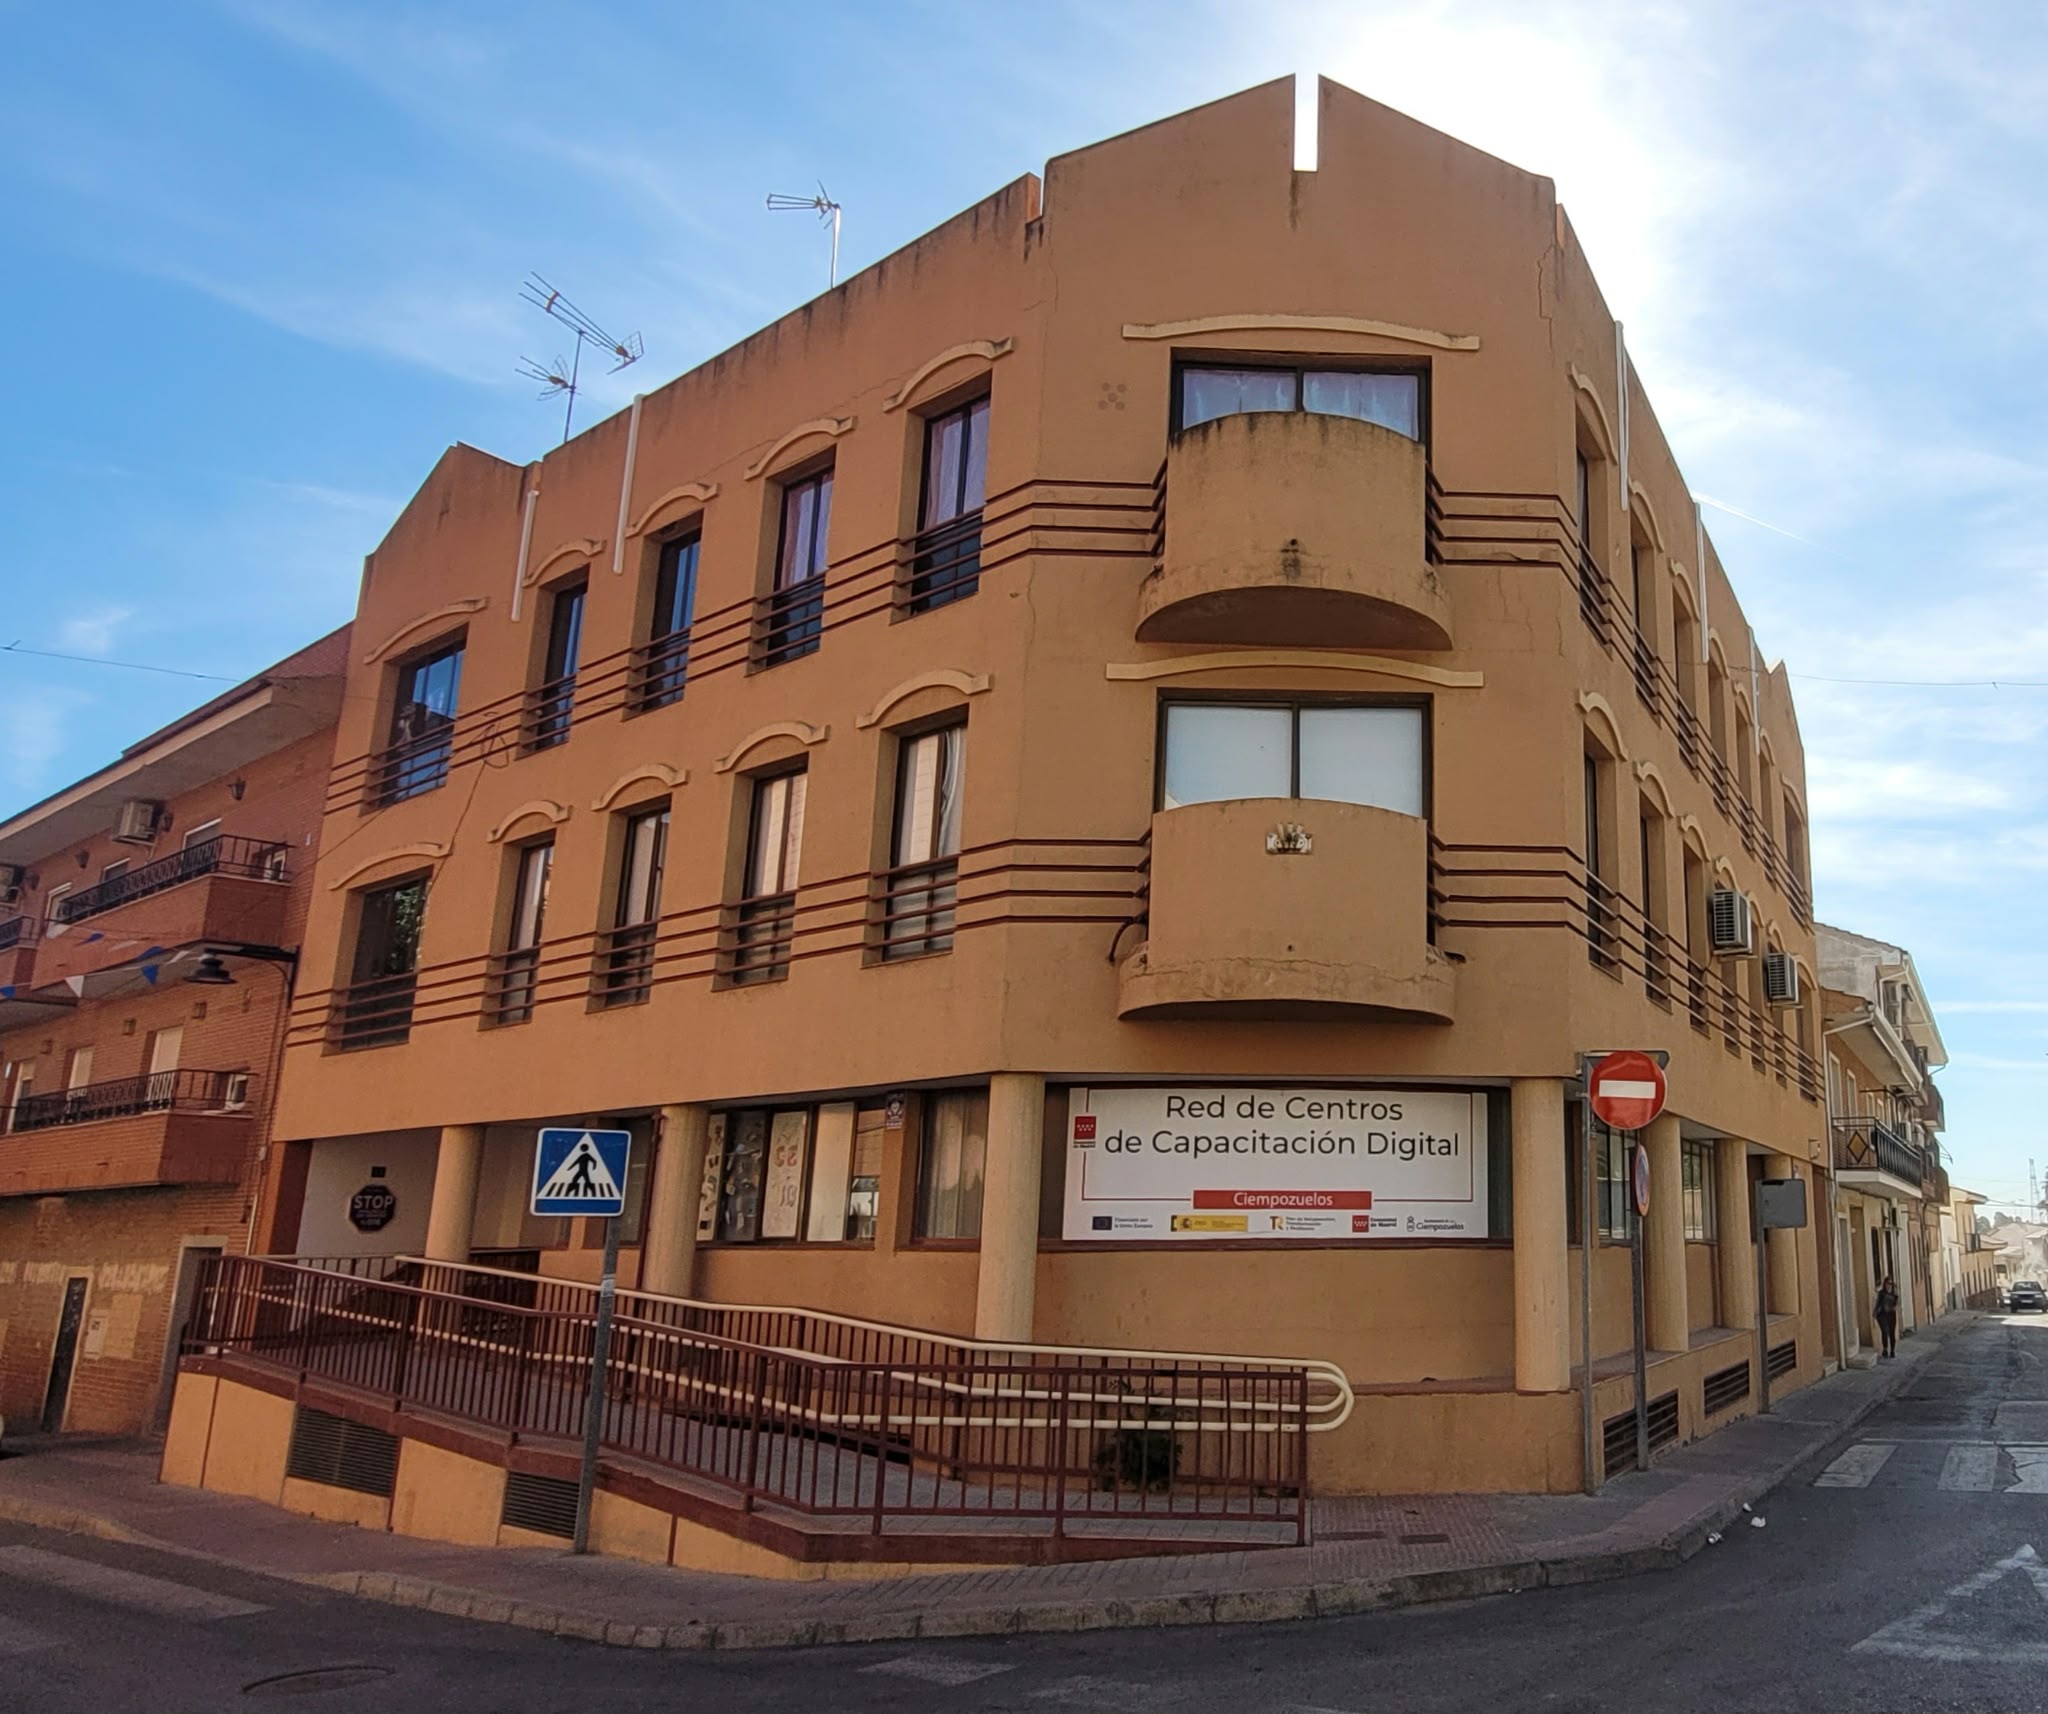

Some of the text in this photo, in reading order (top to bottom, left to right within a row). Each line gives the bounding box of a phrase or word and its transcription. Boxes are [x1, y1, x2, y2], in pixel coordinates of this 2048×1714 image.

[1166, 1094, 1403, 1120] Red de Centros
[1104, 1129, 1458, 1161] de Capacitación Digital
[353, 1195, 393, 1209] STOP
[1233, 1192, 1333, 1208] Ciempozuelos
